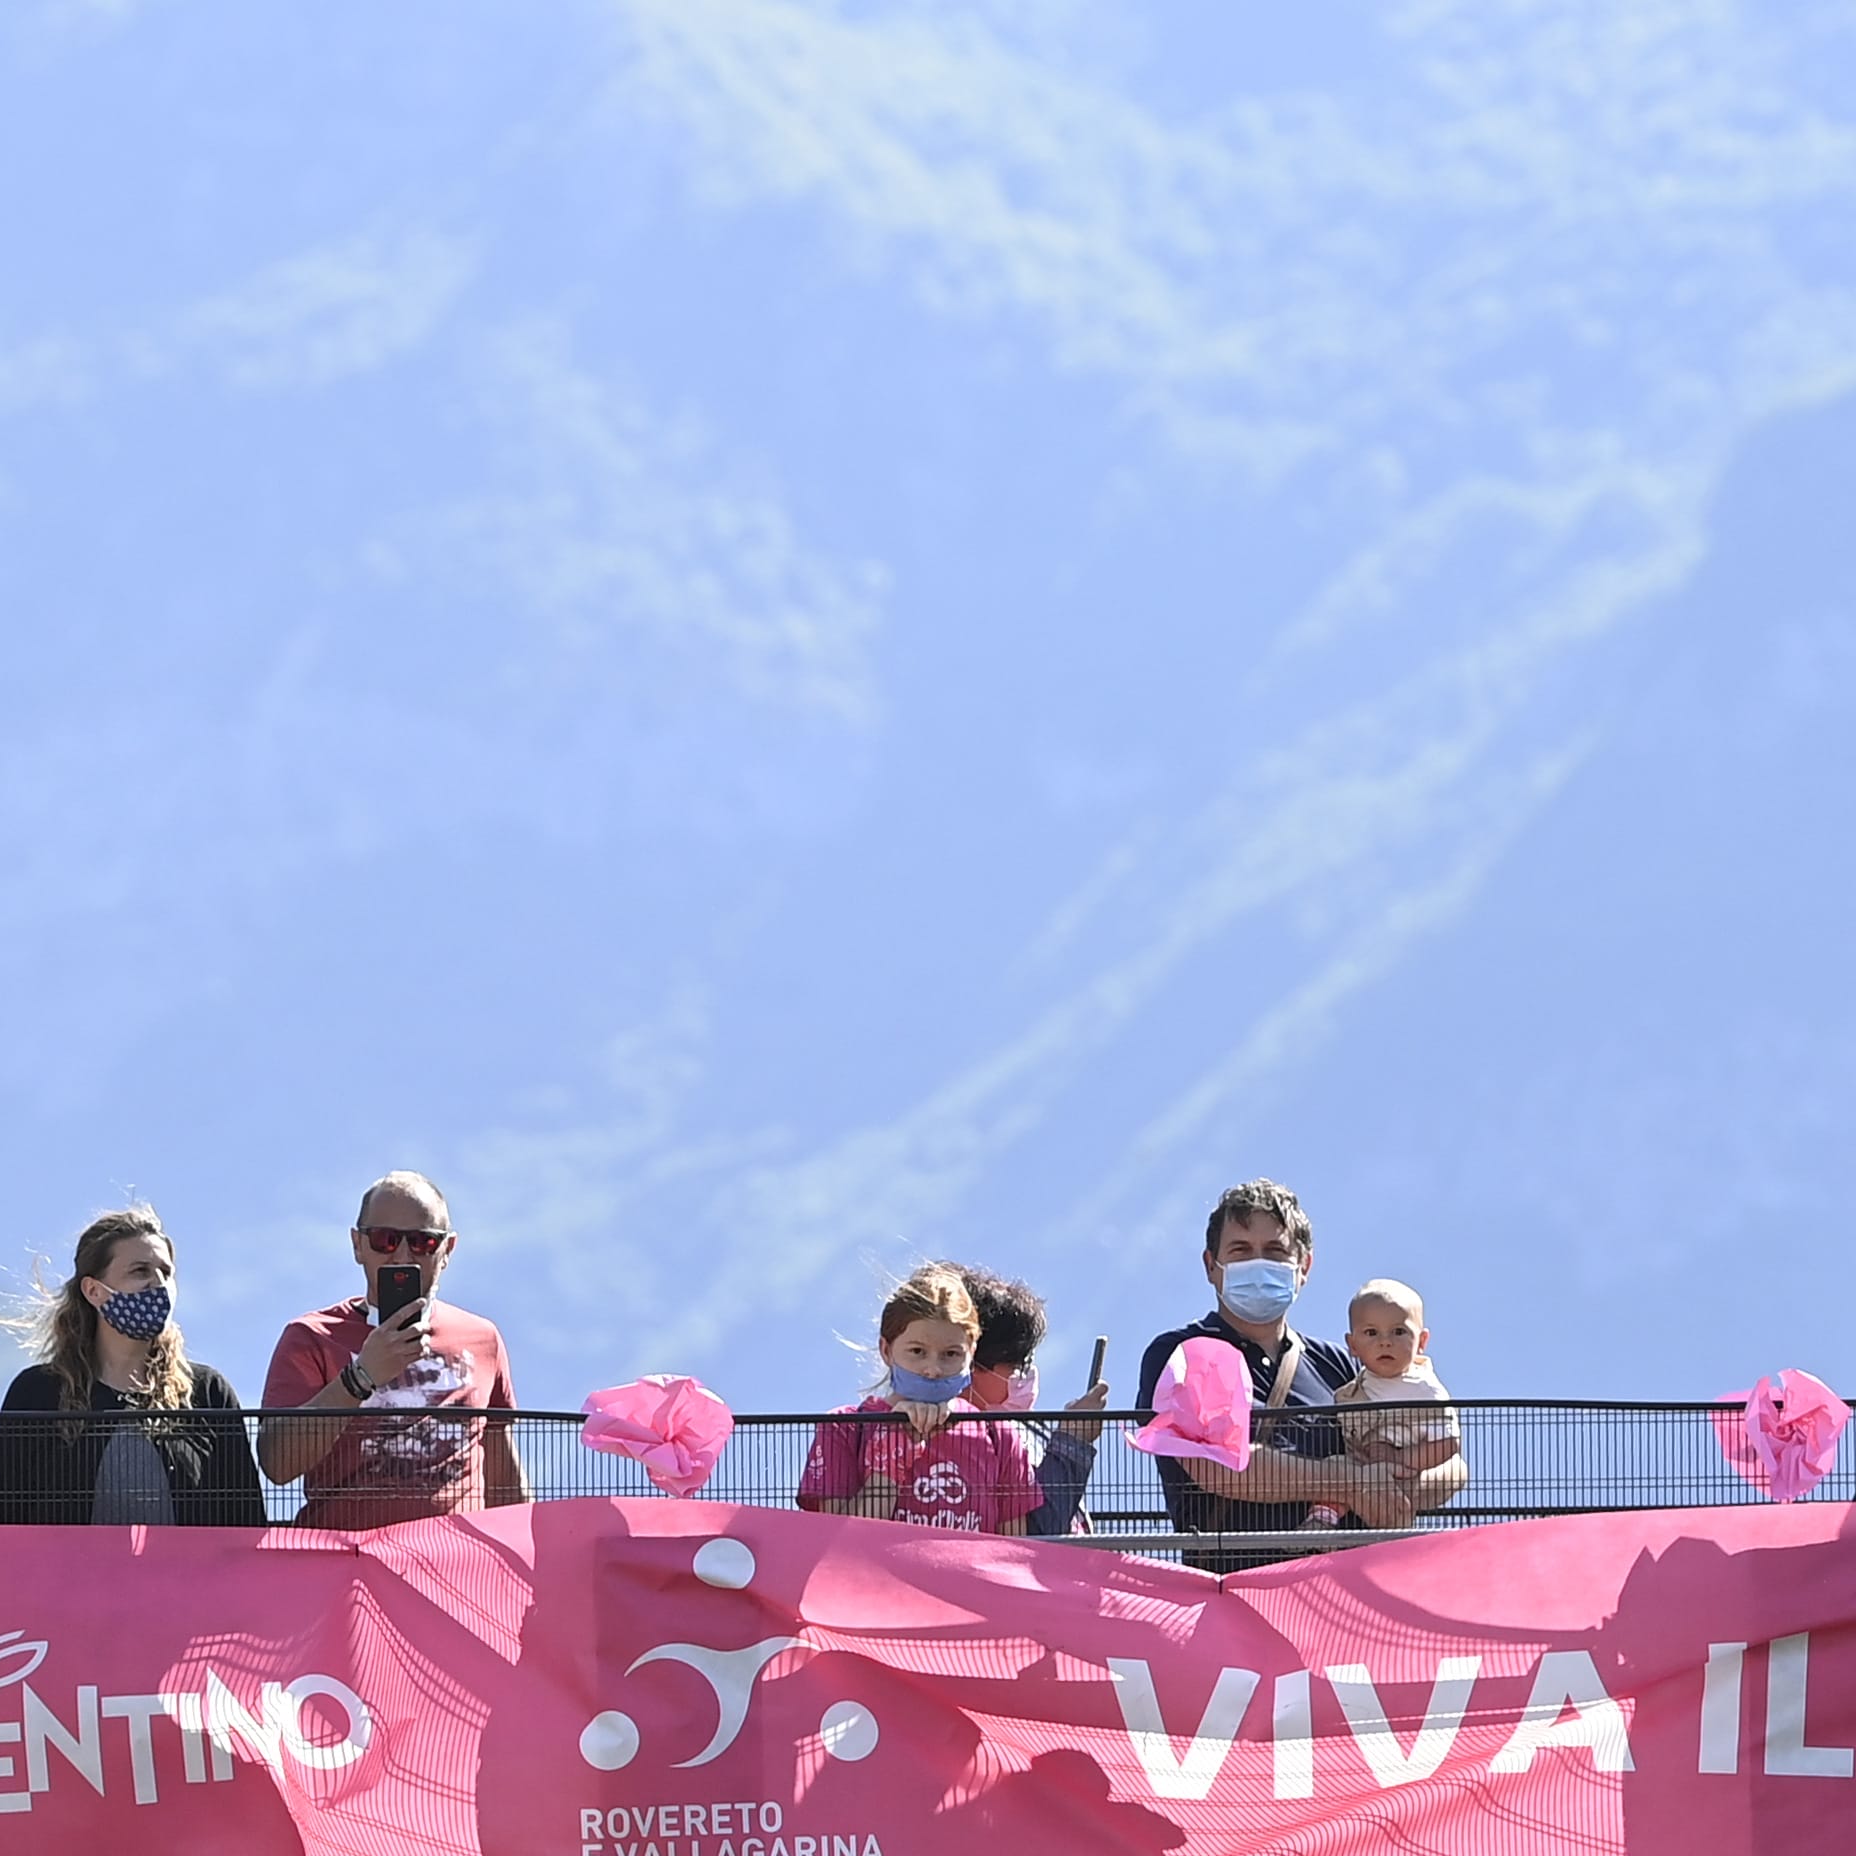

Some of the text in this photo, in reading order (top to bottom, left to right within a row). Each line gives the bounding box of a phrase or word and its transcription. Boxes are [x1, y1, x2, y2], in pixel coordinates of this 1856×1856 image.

[1106, 1650, 1636, 1801] VIVA
[1698, 1632, 1854, 1777] IL
[580, 1801, 782, 1840] ROVERETO
